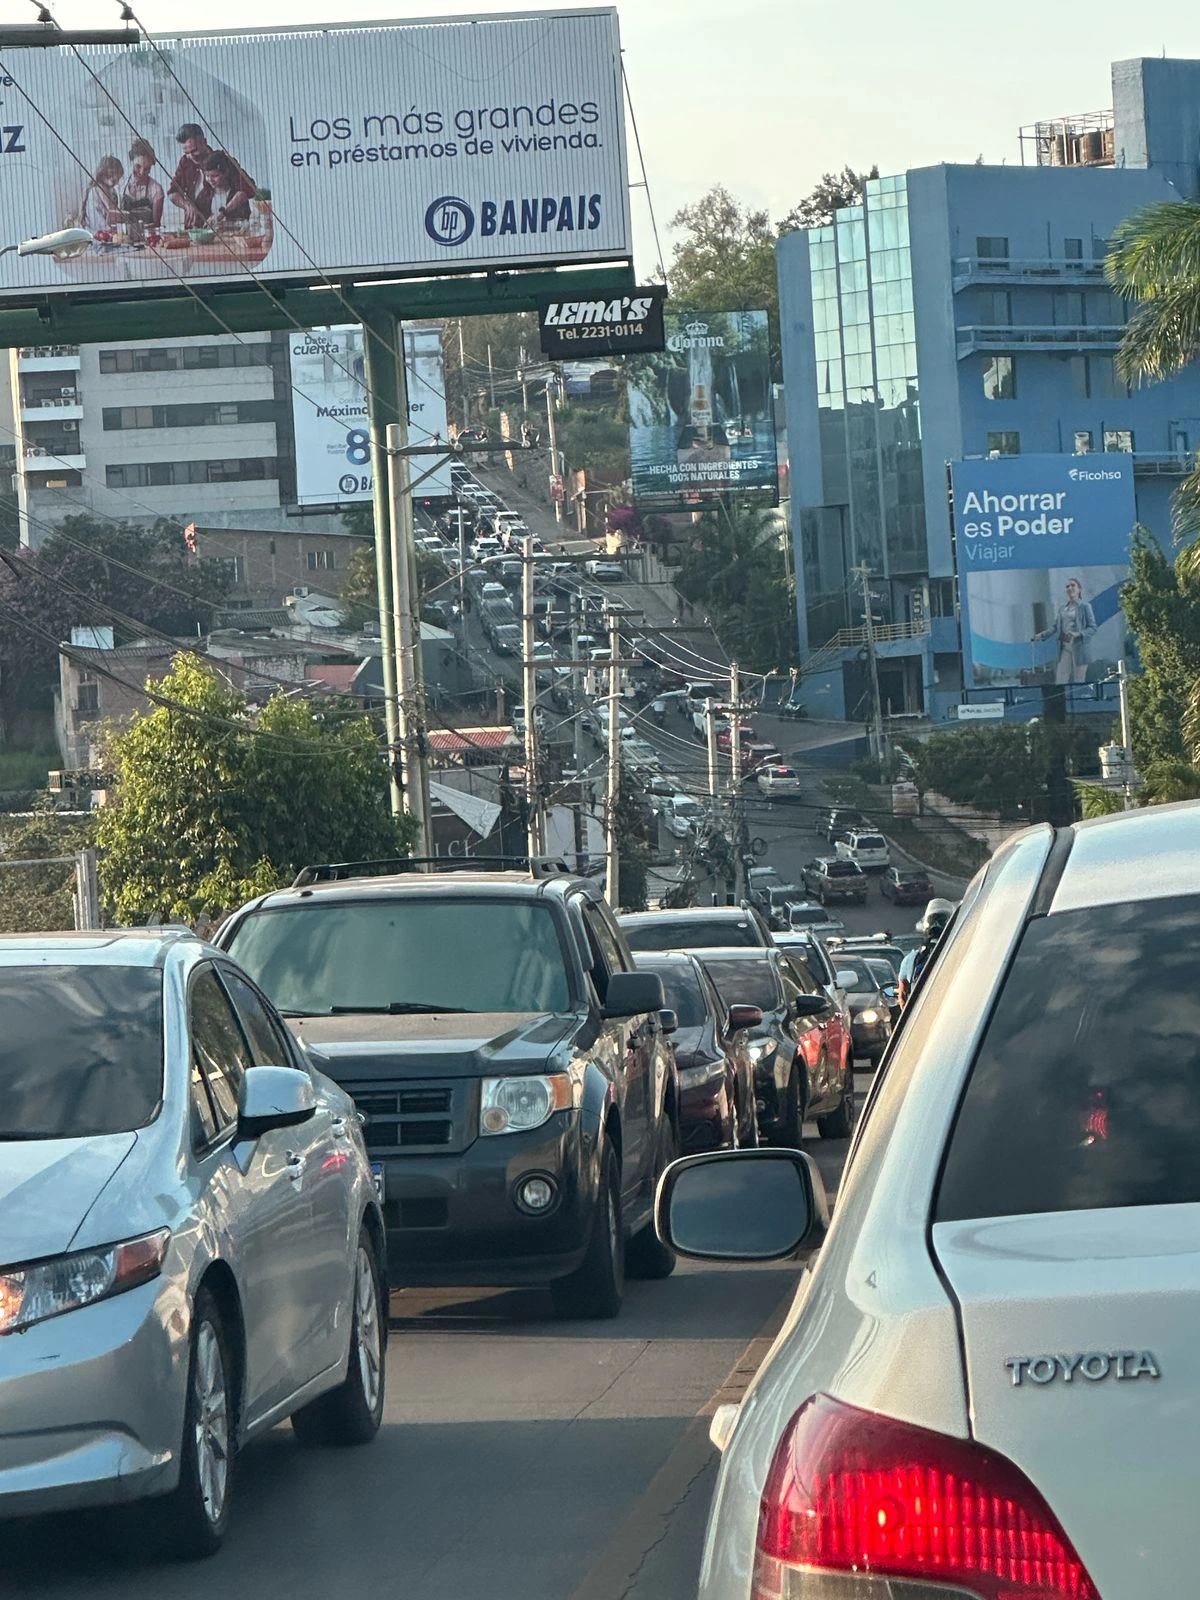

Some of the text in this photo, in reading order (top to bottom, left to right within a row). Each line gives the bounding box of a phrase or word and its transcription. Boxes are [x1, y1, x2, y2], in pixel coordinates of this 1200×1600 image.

[290, 98, 600, 142] Los más grandes
[290, 131, 603, 169] en préstamos de vivienda.
[480, 193, 602, 237] BANPAIS
[557, 323, 644, 340] Tel. 2231-0114
[293, 342, 339, 356] cuenta
[666, 334, 725, 353] Corona
[346, 428, 371, 465] 8
[649, 459, 759, 475] HECHA CON INGREDIENTES
[668, 469, 741, 483] 100% NATURALES
[1078, 470, 1122, 481] Ficohsa
[962, 489, 1067, 515] Ahorrar
[963, 513, 1075, 538] es Poder
[965, 543, 1016, 563] Viajar
[1005, 1350, 1161, 1387] TOYOTA
